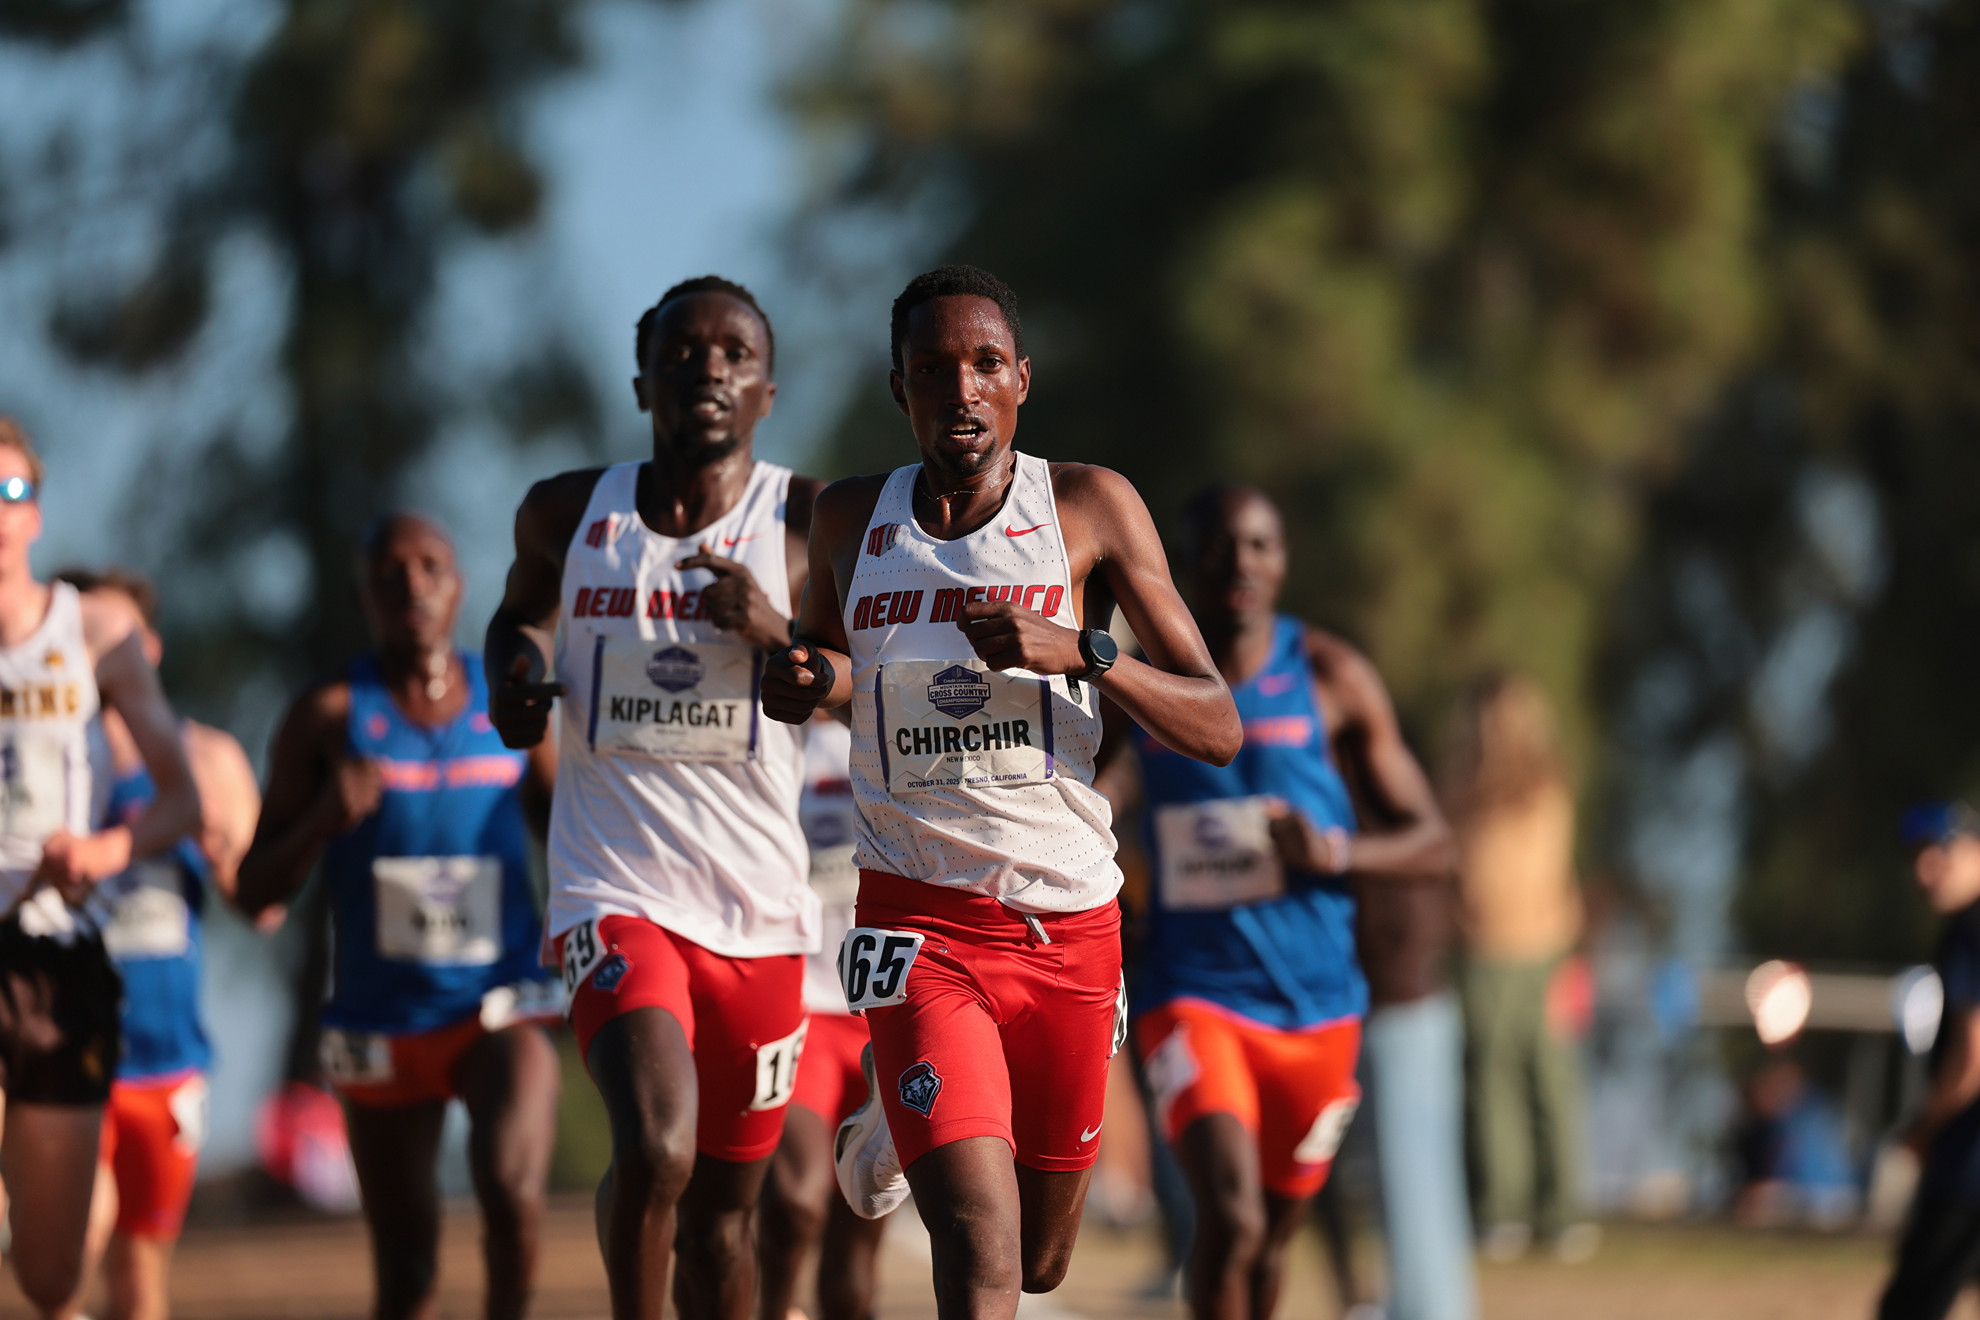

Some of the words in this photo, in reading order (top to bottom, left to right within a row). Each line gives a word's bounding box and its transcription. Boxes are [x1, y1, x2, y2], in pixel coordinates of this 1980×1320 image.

[573, 587, 637, 618] NEW
[853, 590, 924, 631] NEW
[929, 689, 952, 699] CROSS
[953, 688, 988, 697] COUNTRY
[610, 696, 737, 728] KIPLAGAT
[896, 719, 1032, 756] CHIRCHIR
[907, 779, 935, 788] OCTOBER
[935, 778, 945, 786] 31,
[964, 776, 990, 785] FRESNO,
[991, 773, 1028, 782] CALIFORNIA
